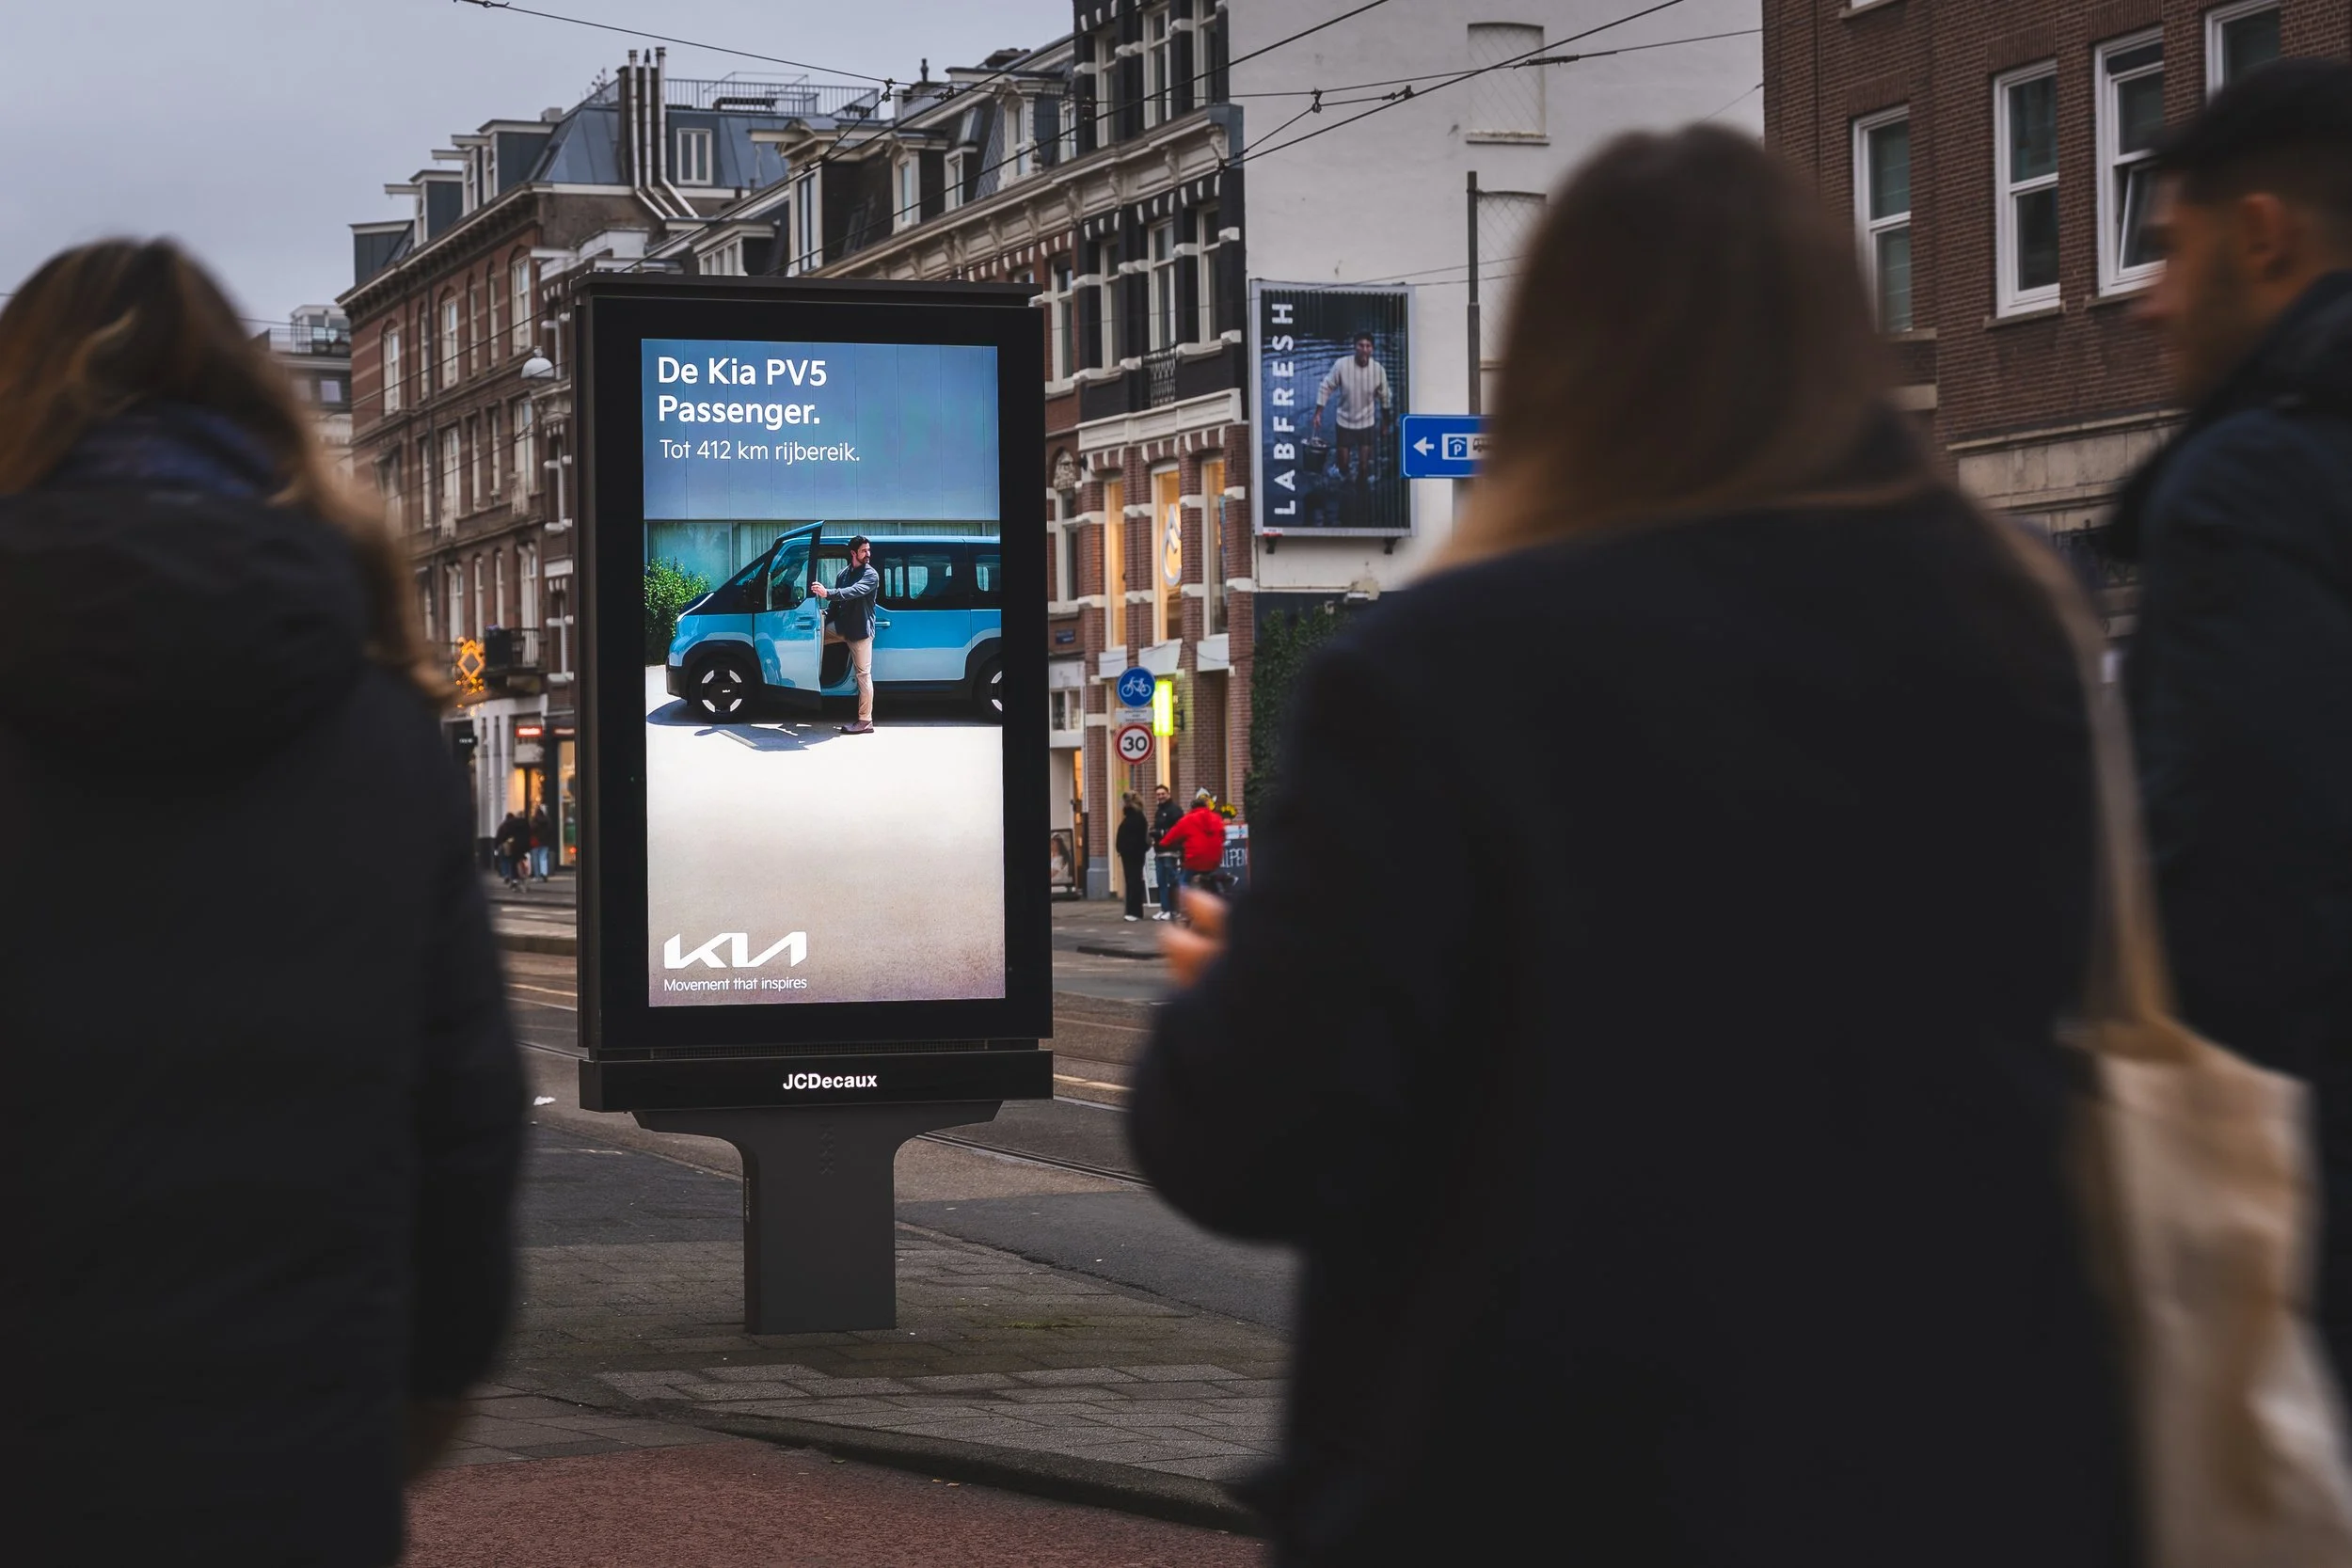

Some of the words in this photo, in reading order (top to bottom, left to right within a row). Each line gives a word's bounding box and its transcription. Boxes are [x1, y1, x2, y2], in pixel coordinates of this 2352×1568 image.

[659, 356, 699, 384] De
[708, 357, 756, 385] Kia
[767, 358, 827, 387] PV5
[659, 395, 820, 431] Passenger.
[1272, 303, 1295, 516] LABFRESH
[660, 438, 691, 459] Tot
[696, 439, 731, 460] 412
[738, 440, 769, 460] km
[775, 441, 861, 466] rijbereik.
[1454, 443, 1462, 456] P
[1122, 736, 1148, 752] 30
[663, 931, 807, 969] KIA
[663, 978, 730, 992] Movement
[733, 977, 758, 990] that
[761, 976, 807, 992] inspires
[783, 1072, 878, 1090] JCDecaux
